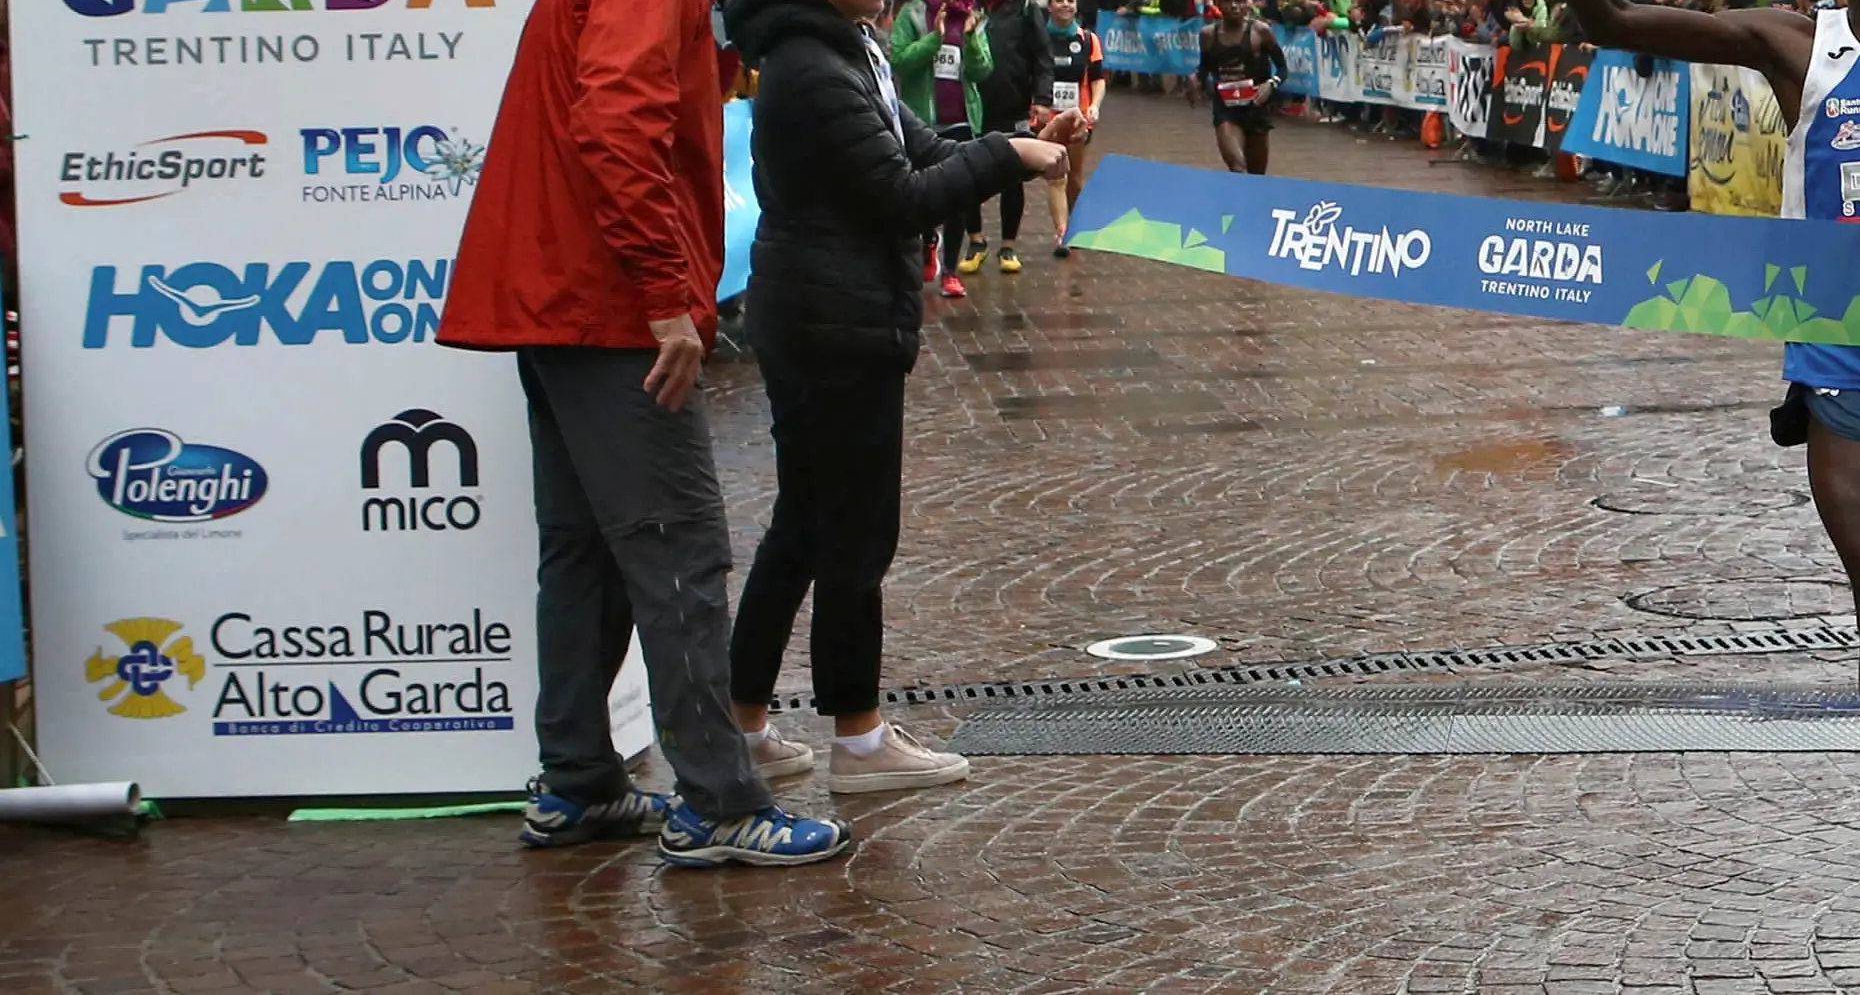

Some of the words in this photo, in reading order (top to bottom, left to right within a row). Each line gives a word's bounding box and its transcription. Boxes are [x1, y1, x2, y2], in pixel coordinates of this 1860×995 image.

[84, 34, 320, 66] TRENTINO
[346, 32, 464, 62] ITALY
[1655, 72, 1680, 113] ONE
[300, 125, 452, 184] PEJO
[1653, 113, 1679, 157] ONE
[60, 151, 266, 186] EthicSport
[302, 185, 370, 202] FONTE
[374, 184, 446, 201] ALPINA
[1268, 208, 1431, 278] TRENTINO
[1506, 218, 1552, 234] NORTH
[1556, 222, 1590, 237] LAKE
[361, 259, 455, 300] ON
[1477, 235, 1603, 284] GARDA
[83, 261, 369, 349] HOKA
[1481, 280, 1549, 299] TRENTINO
[1555, 288, 1591, 303] ITALY
[370, 304, 441, 344] ON
[86, 427, 253, 514] Polenghi
[362, 495, 481, 532] mico
[211, 612, 354, 660] Cassa
[365, 608, 511, 657] Rurale
[213, 671, 325, 718] Alto
[360, 667, 511, 716] Garda
[228, 722, 280, 734] Banca
[290, 722, 306, 733] di
[314, 720, 379, 732] Credito
[389, 719, 496, 731] Cooperativo
